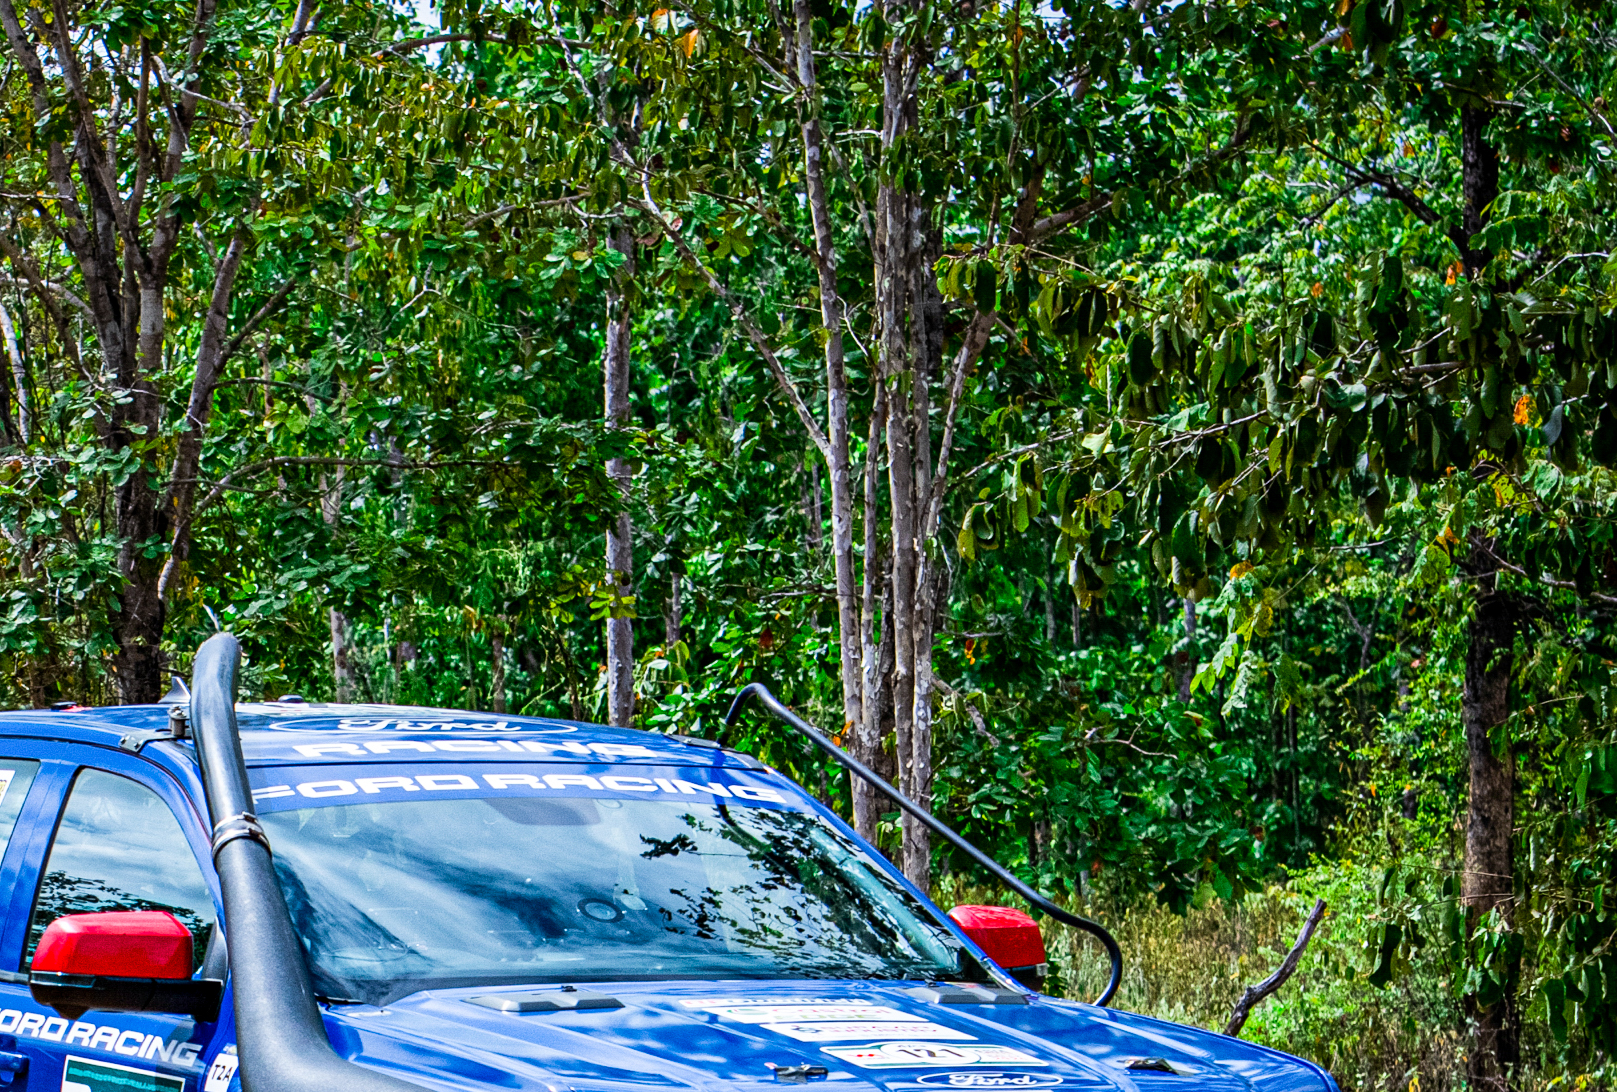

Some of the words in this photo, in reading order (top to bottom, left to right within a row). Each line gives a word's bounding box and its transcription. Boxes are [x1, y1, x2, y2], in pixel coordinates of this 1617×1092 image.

[338, 717, 522, 731] Ford
[292, 740, 658, 758] RACING
[251, 774, 481, 805] FORD
[482, 774, 788, 804] RACING
[66, 1020, 203, 1068] RACING
[212, 1064, 233, 1082] T2A
[948, 1073, 1037, 1087] Ford
